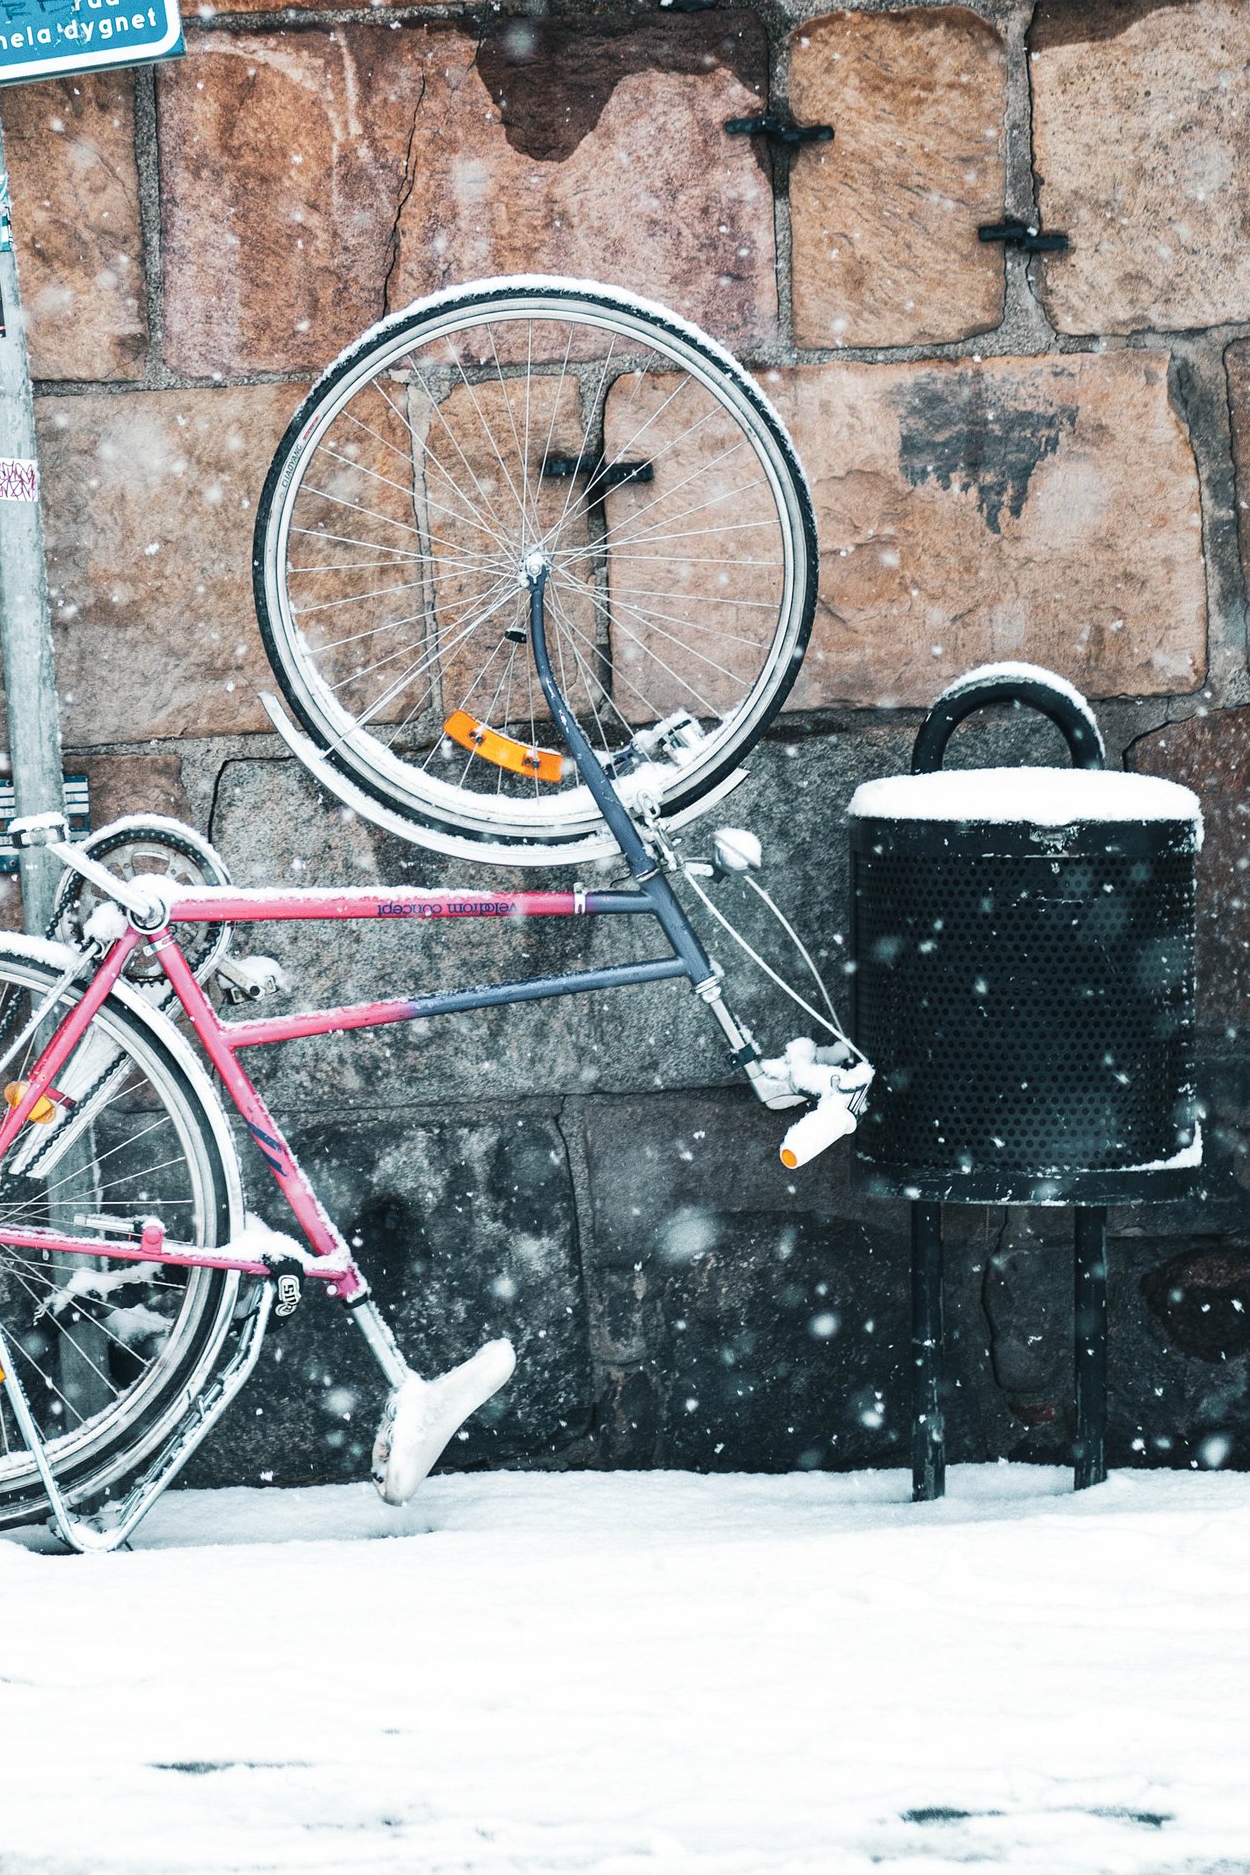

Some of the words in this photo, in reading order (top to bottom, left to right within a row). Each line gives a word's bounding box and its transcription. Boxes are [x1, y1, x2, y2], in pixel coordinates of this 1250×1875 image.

[64, 7, 157, 41] dygnet
[377, 902, 442, 916] concept
[447, 902, 517, 916] velodrom
